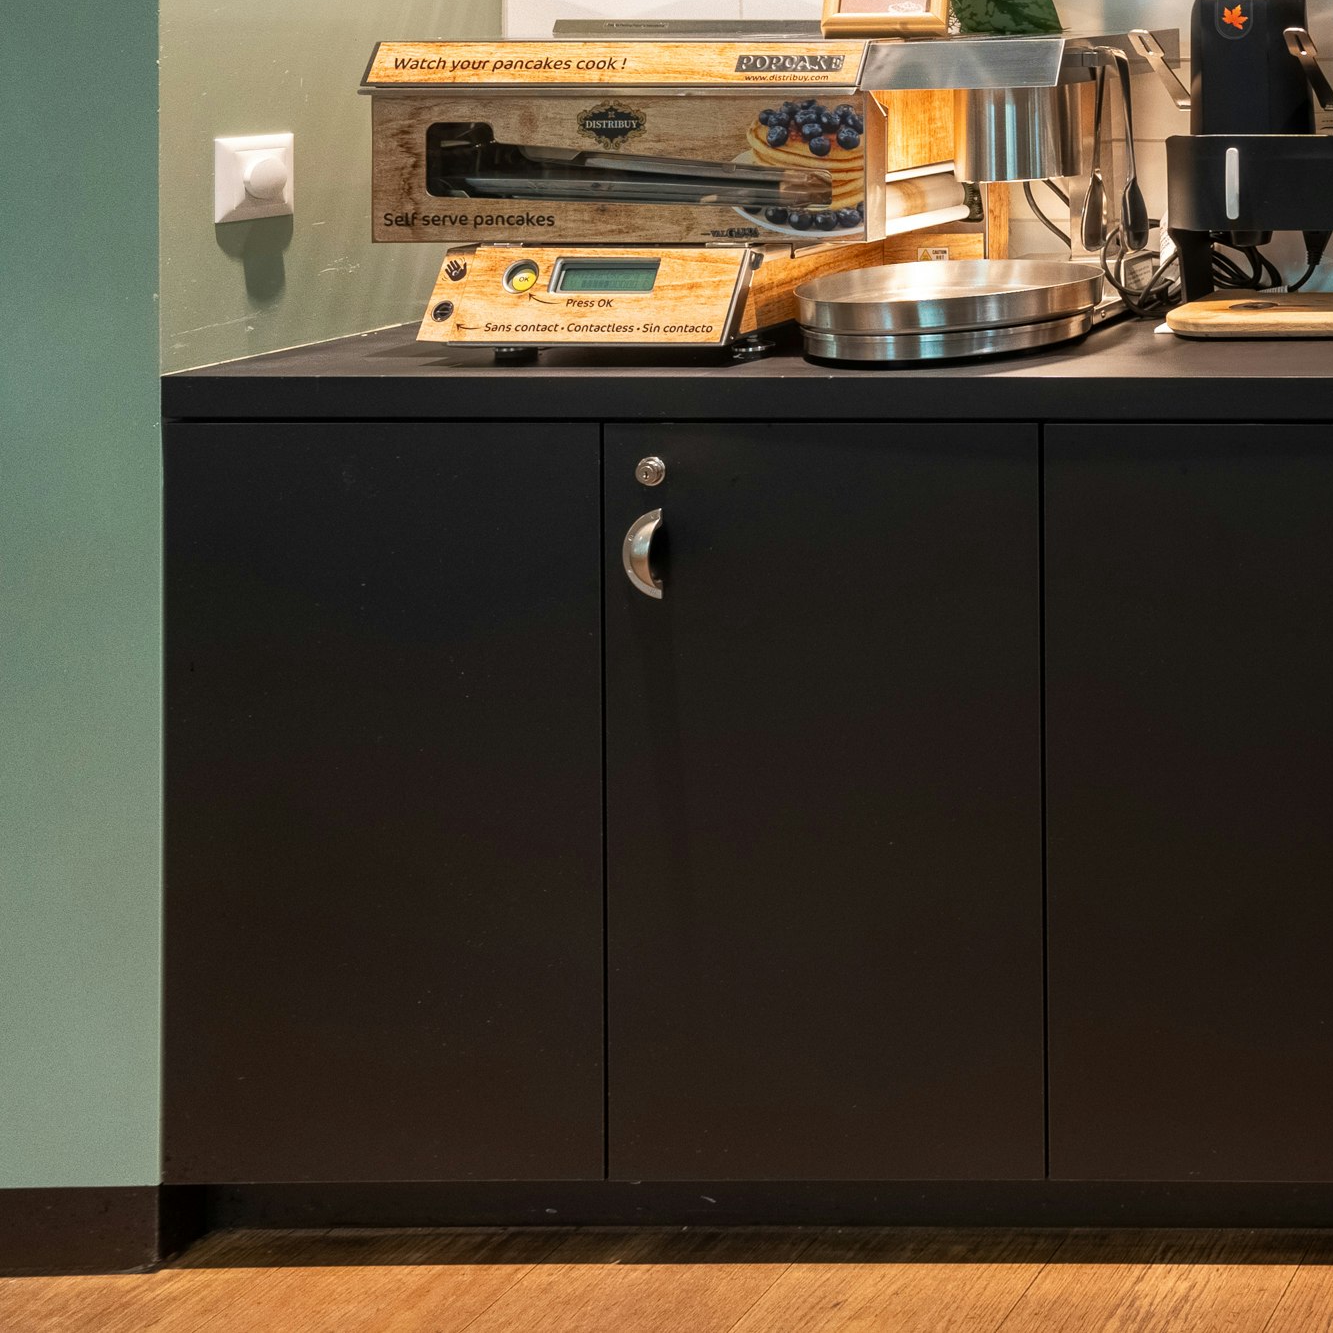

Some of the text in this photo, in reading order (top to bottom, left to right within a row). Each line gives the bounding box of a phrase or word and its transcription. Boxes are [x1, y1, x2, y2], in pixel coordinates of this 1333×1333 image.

[393, 57, 447, 70] Watch
[449, 59, 489, 72] your
[492, 57, 571, 72] pancakes
[576, 57, 617, 70] cook
[741, 55, 844, 70] POPCAKE
[585, 120, 638, 129] DISTRIBUY
[384, 212, 556, 229] Self serve pancakes
[565, 299, 613, 307] Press OK
[484, 323, 713, 333] Sans contact Contactless Sin contacto
